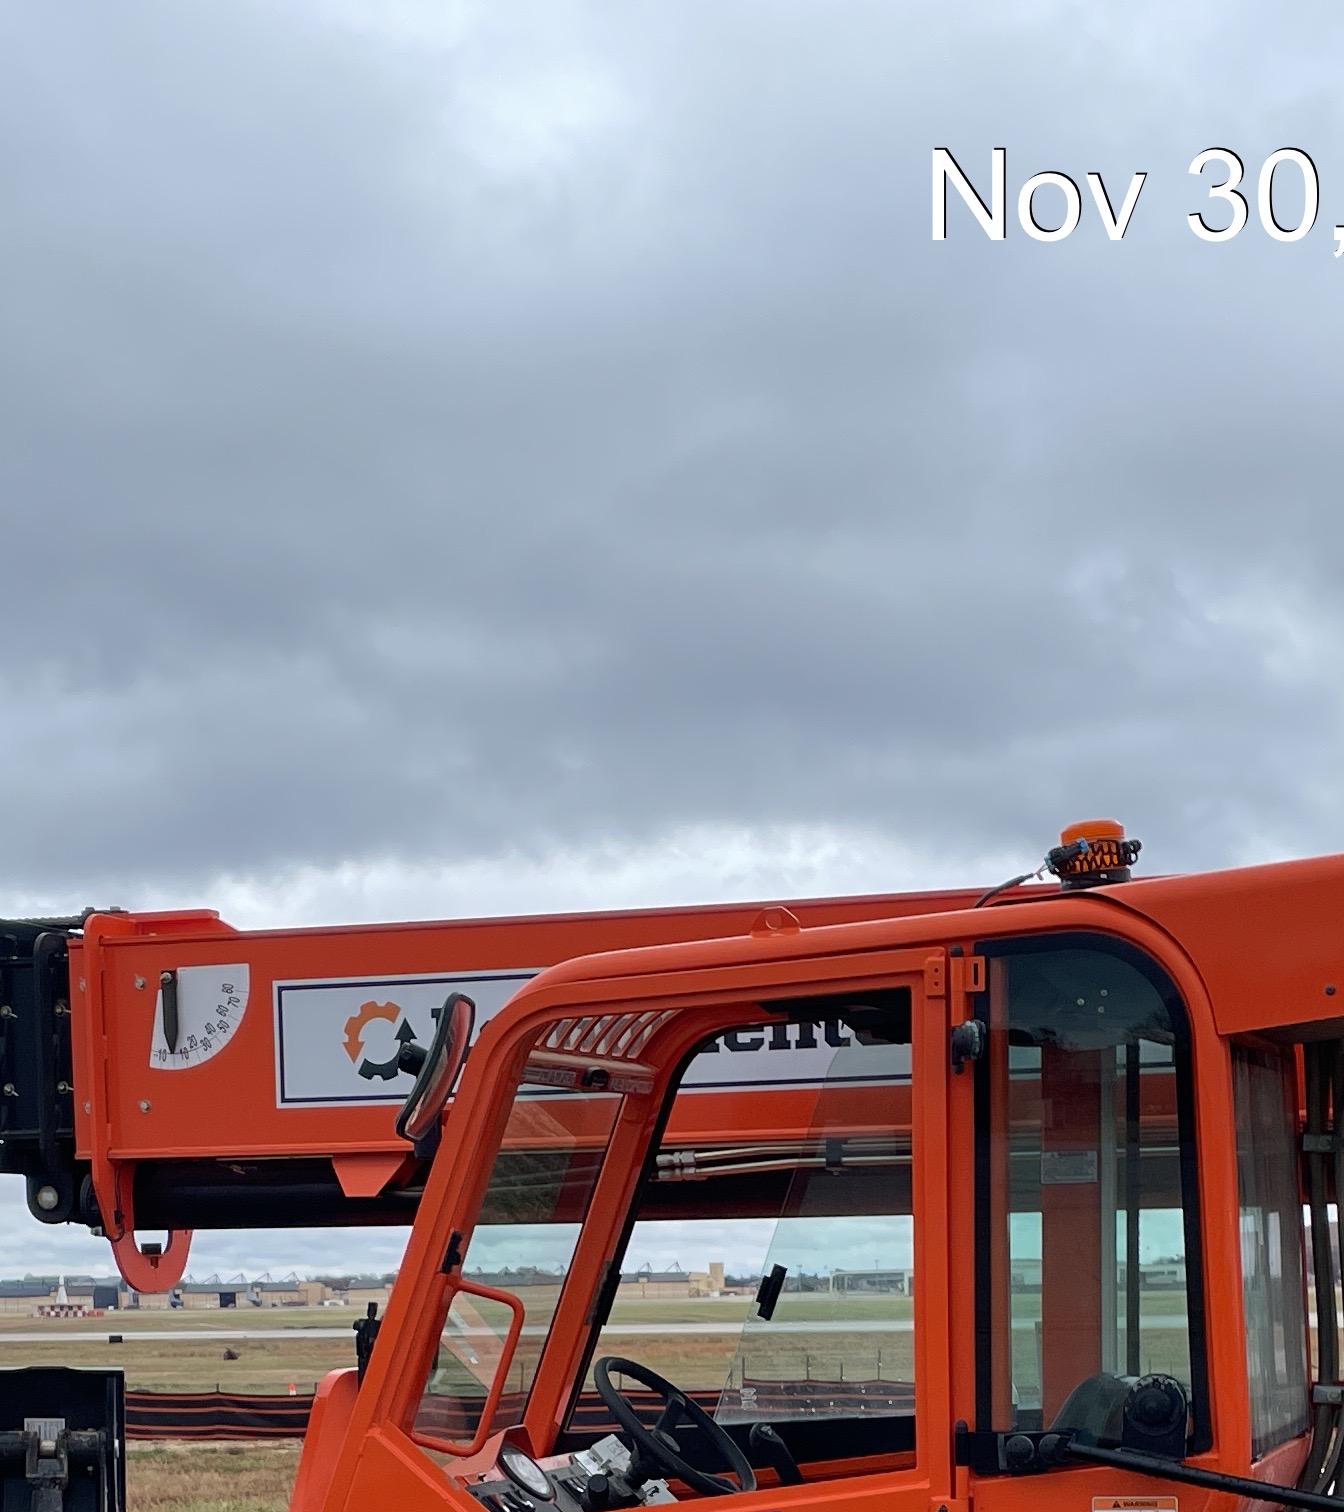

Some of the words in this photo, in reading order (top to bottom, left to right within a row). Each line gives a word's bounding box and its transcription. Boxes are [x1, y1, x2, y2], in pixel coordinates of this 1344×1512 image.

[227, 996, 241, 1008] 70
[216, 1004, 229, 1017] 60
[204, 1022, 216, 1036] 40
[217, 1019, 230, 1034] 50
[187, 1034, 198, 1049] 20
[200, 1037, 212, 1052] 30
[179, 1046, 190, 1060] 10
